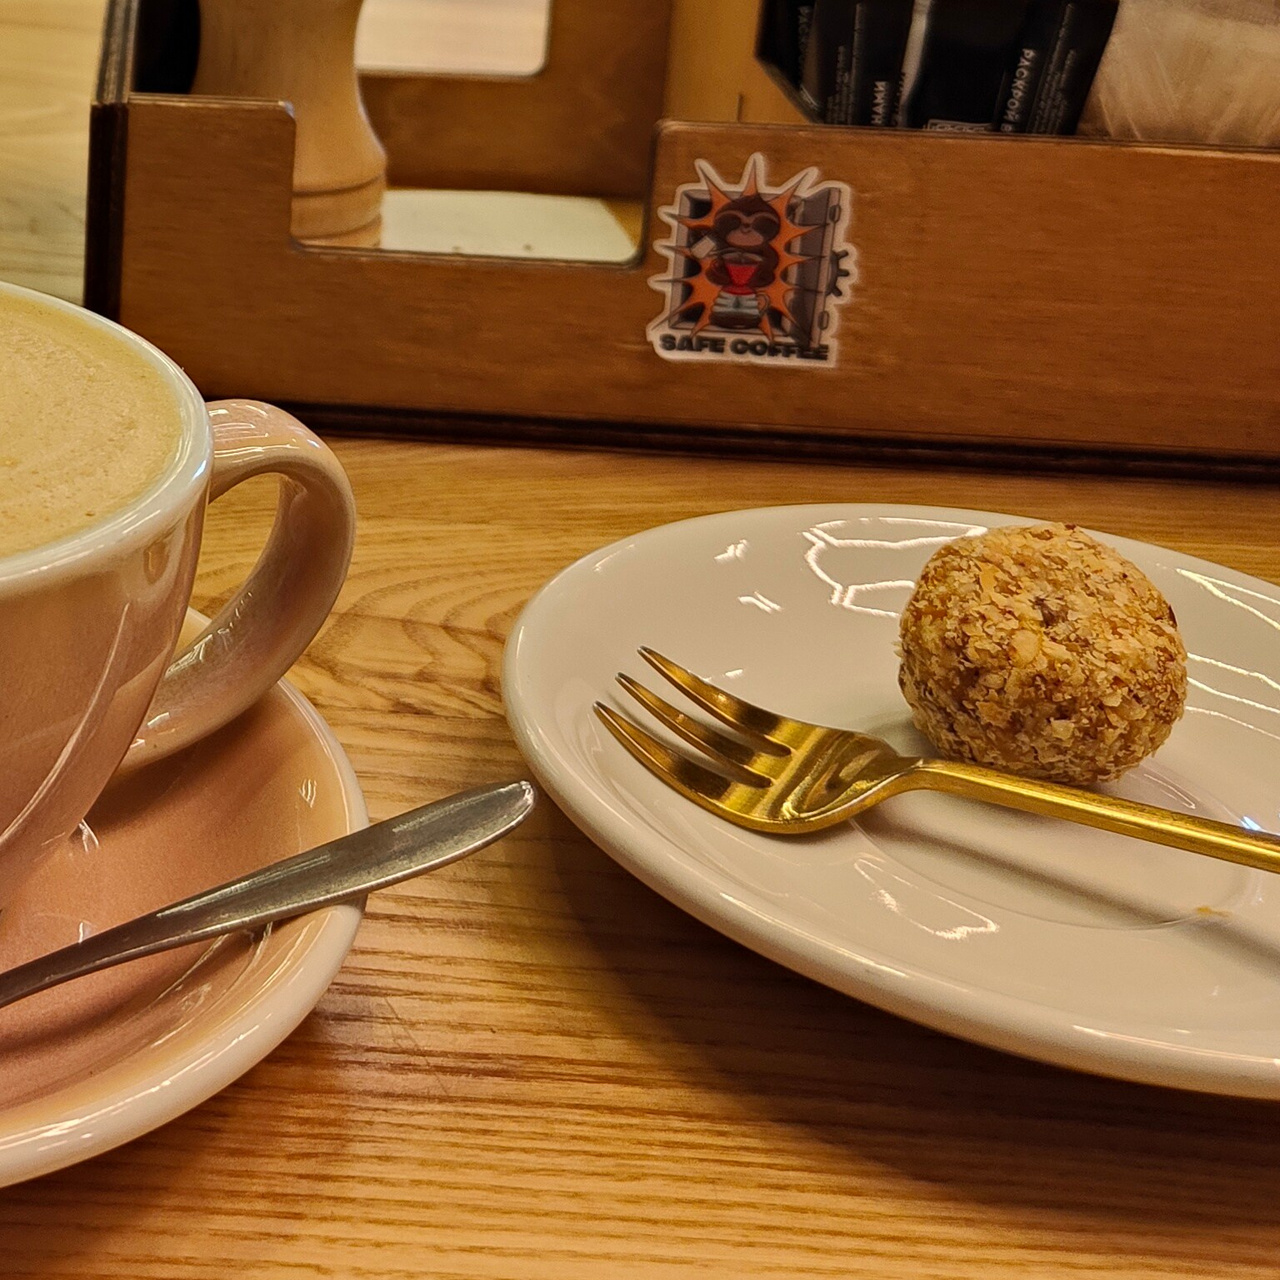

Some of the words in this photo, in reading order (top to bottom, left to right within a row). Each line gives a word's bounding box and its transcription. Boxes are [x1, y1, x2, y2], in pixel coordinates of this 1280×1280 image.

[871, 80, 888, 124] НАМИ
[1003, 48, 1036, 122] РАСКРОЙ
[659, 332, 726, 353] SAFE
[729, 338, 830, 361] COFFEE
